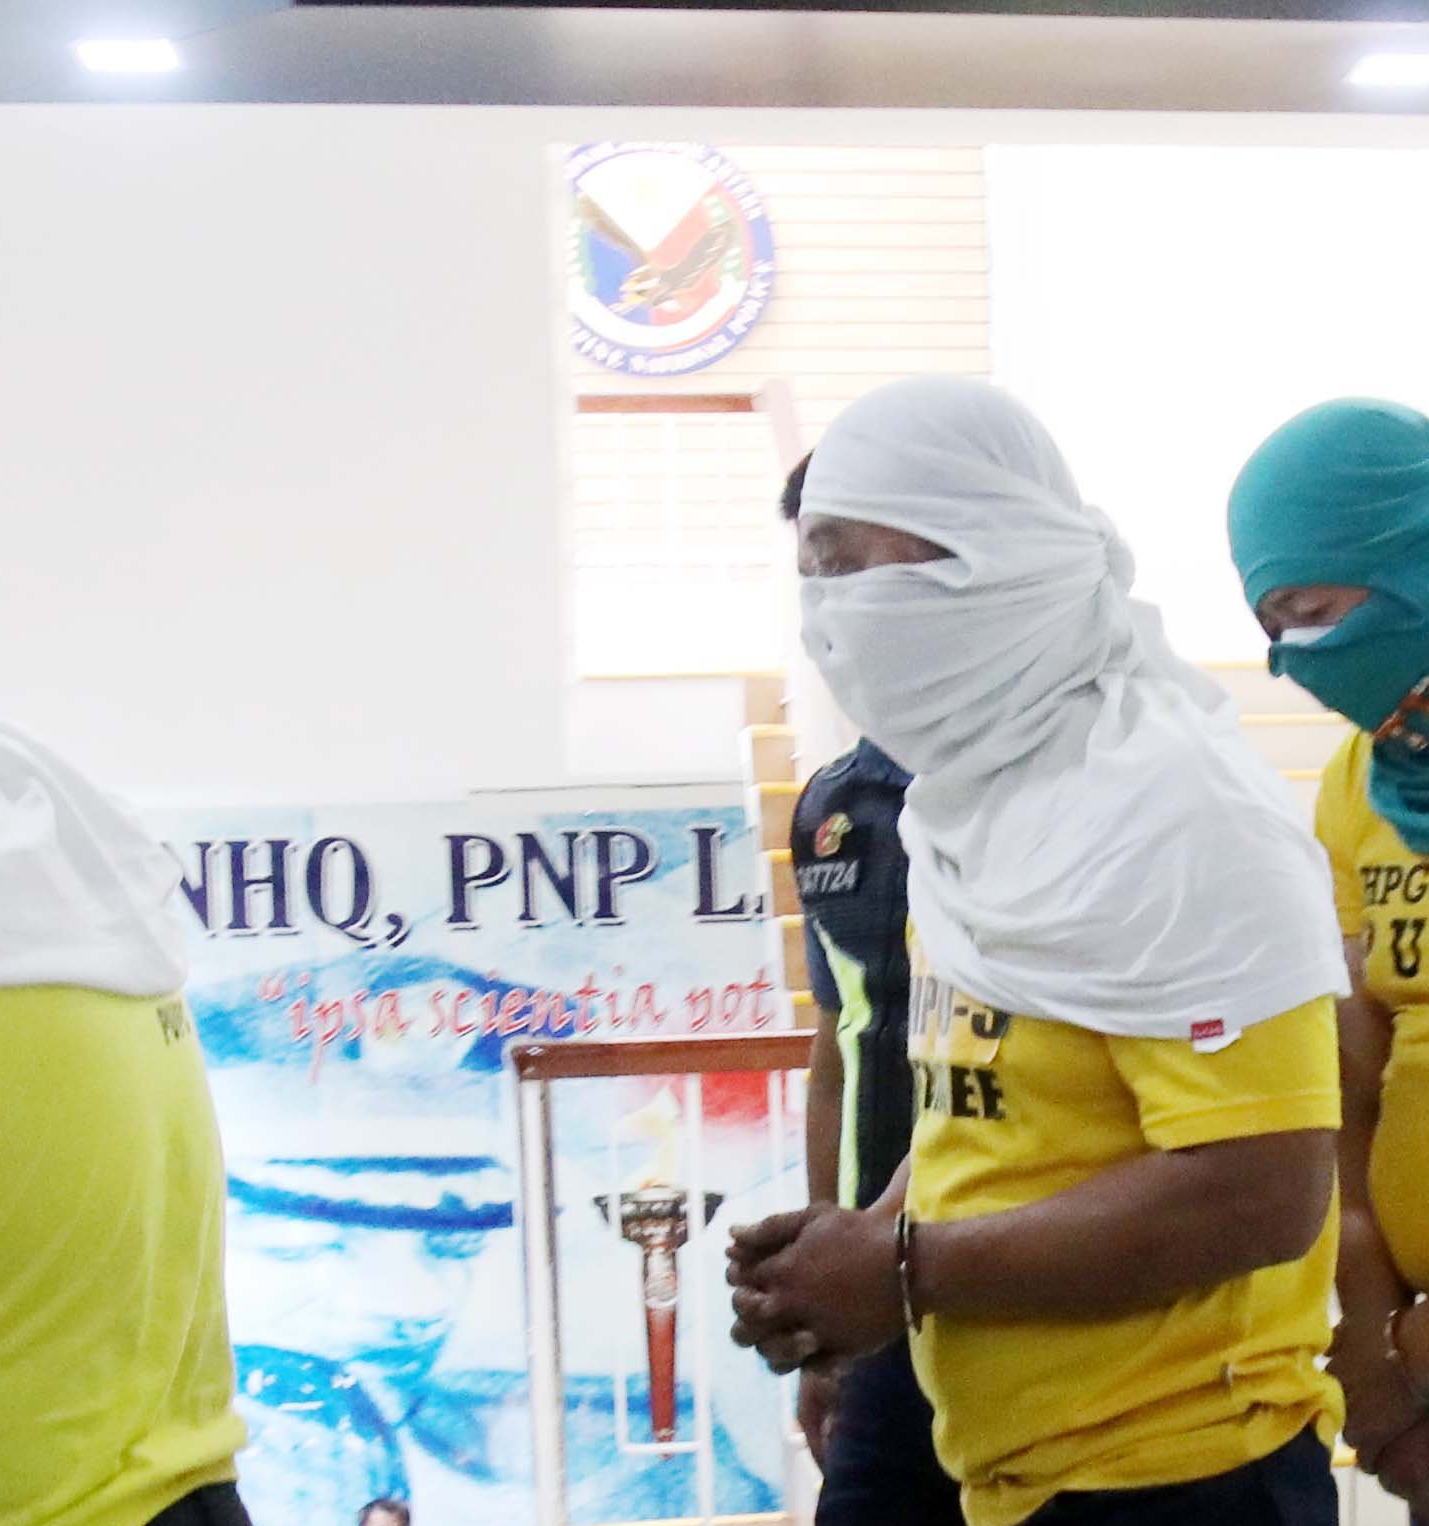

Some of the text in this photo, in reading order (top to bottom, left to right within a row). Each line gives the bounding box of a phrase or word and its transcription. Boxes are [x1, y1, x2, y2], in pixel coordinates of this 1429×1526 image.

[443, 829, 654, 928] PNP
[689, 827, 764, 915] L
[431, 963, 668, 1041] scientia
